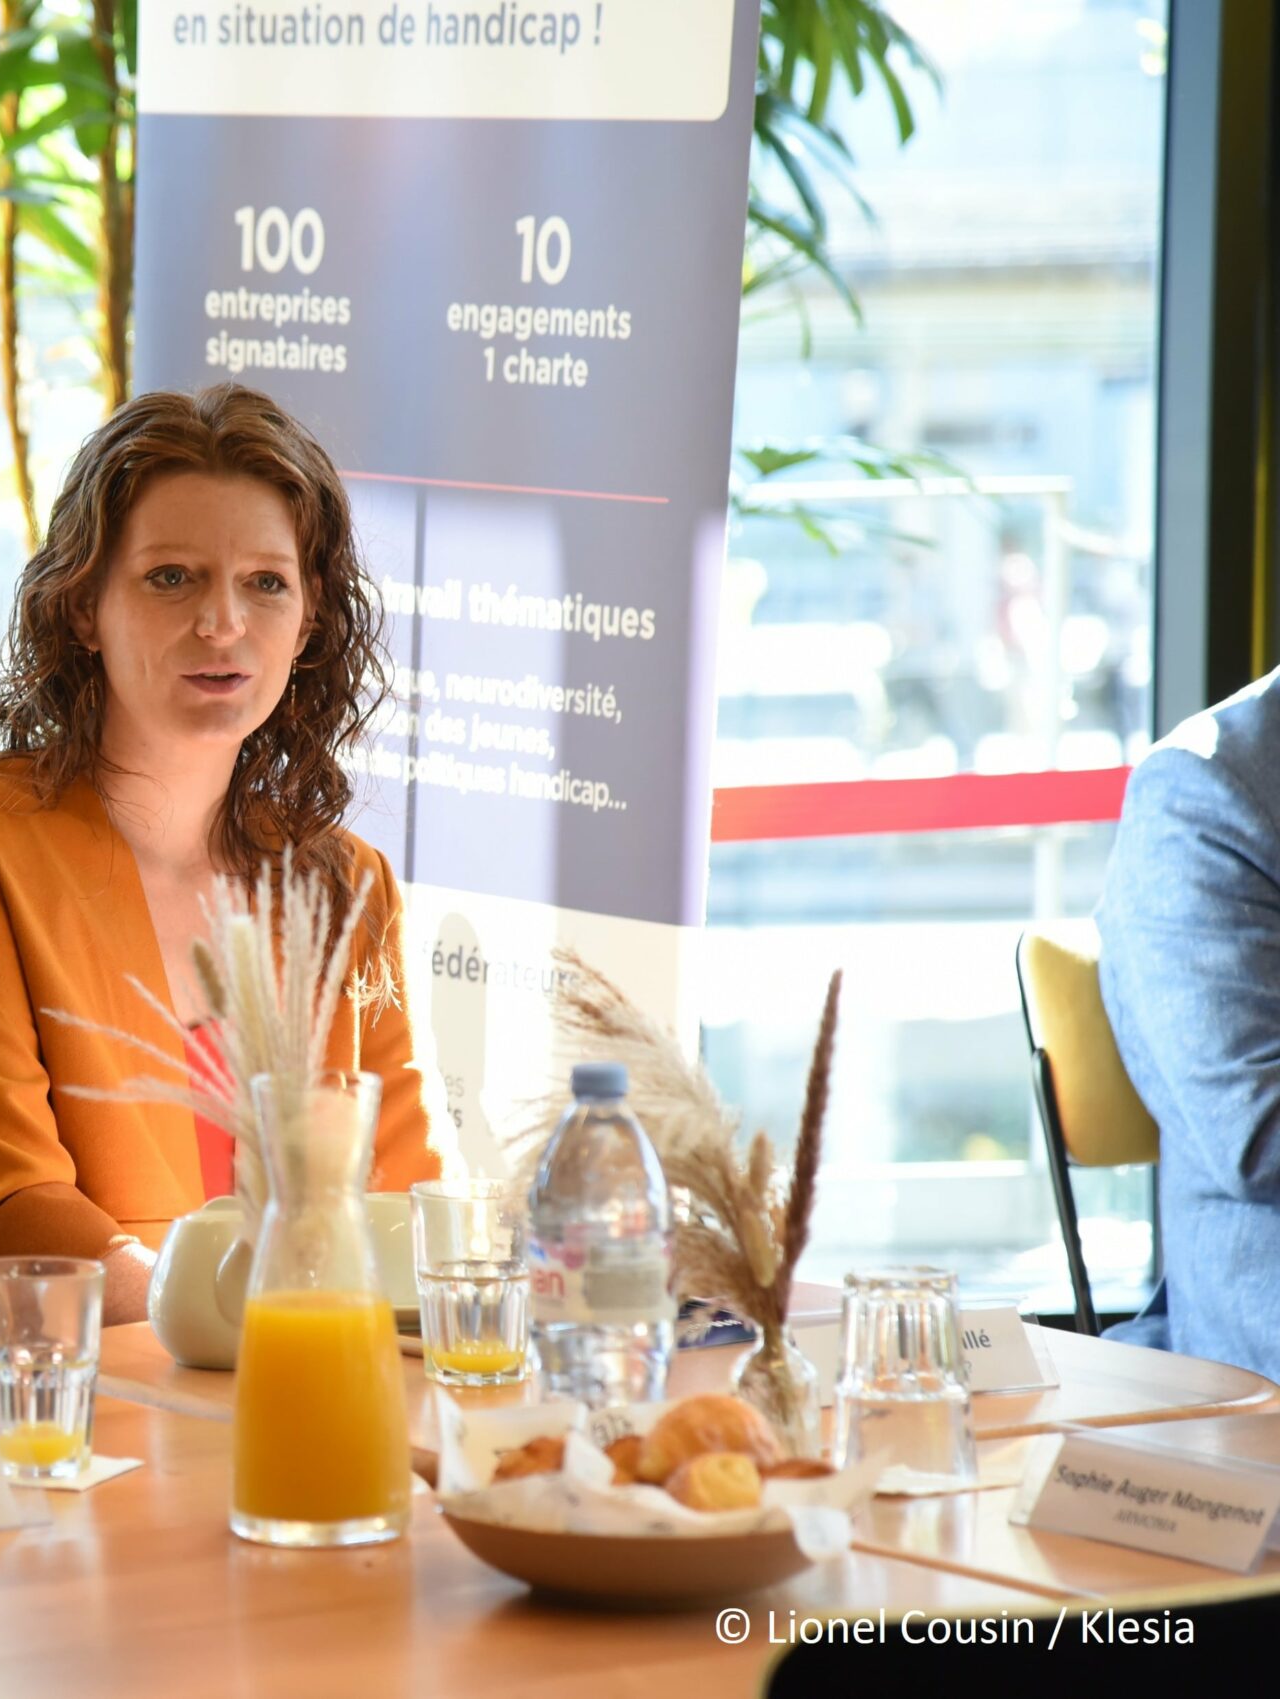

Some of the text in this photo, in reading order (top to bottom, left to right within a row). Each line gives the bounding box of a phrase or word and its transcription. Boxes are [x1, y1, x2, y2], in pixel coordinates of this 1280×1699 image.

[173, 2, 604, 54] en situation de handicap !
[234, 205, 325, 275] 100
[515, 214, 572, 286] 10
[204, 285, 351, 328] entreprises
[446, 302, 632, 341] engagements
[205, 329, 348, 373] signataires
[483, 346, 589, 388] 1 charte
[382, 576, 462, 622] travail
[468, 579, 657, 642] thématiques
[445, 672, 624, 724] neurodiversité,
[425, 708, 467, 744] des
[469, 713, 556, 760] jeunes,
[403, 750, 508, 796] politiques
[509, 761, 628, 813] handicap...
[1055, 1463, 1115, 1494] Sophie
[1117, 1477, 1171, 1506] Auger
